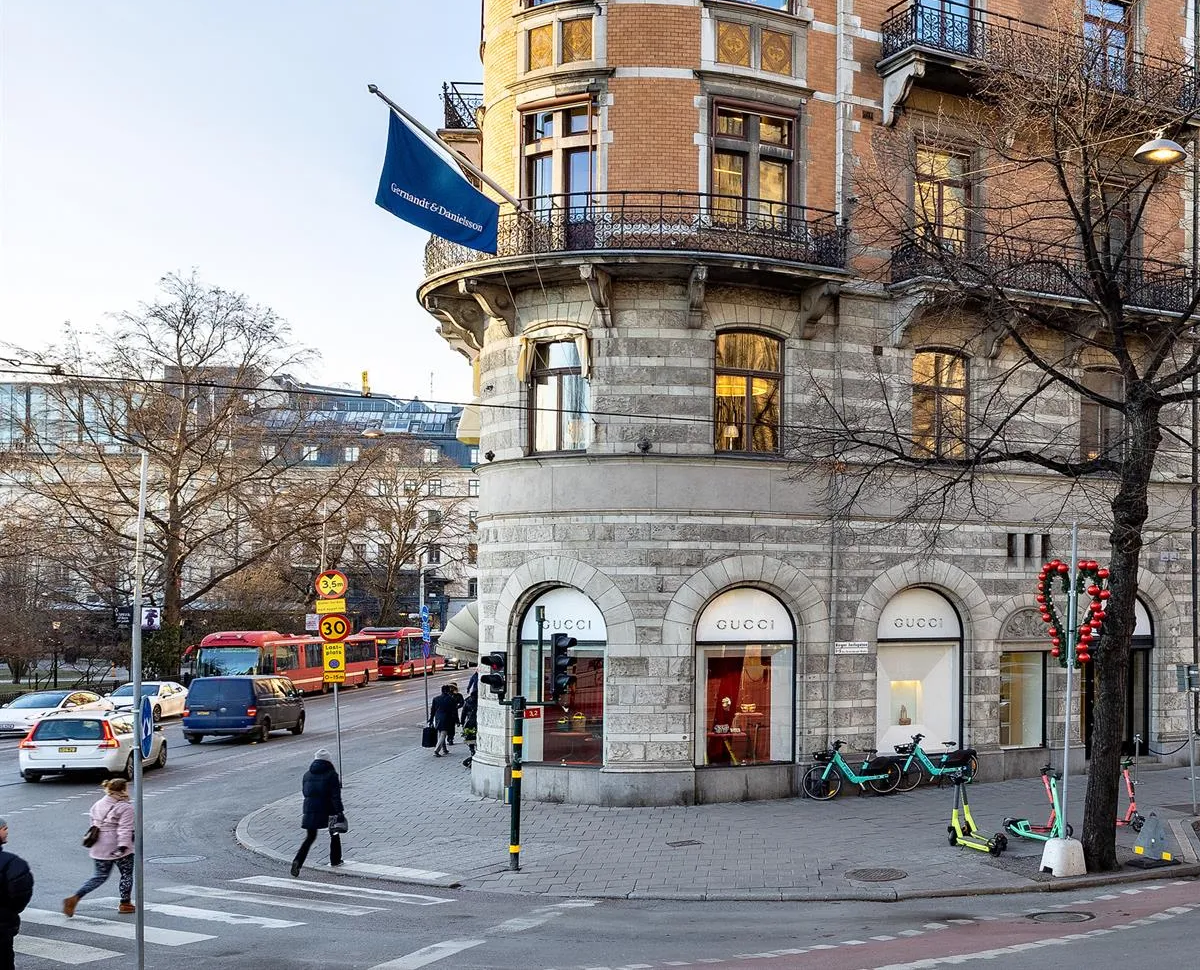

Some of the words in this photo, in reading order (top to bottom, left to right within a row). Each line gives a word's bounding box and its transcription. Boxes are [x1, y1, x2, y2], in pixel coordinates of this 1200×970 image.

[391, 182, 430, 210] Gernandt
[429, 202, 440, 215] &
[438, 206, 483, 232] Danielsson
[322, 620, 345, 636] 30
[542, 619, 591, 630] GUCCI
[716, 619, 774, 630] GUCCI
[894, 617, 943, 628] GUCCI
